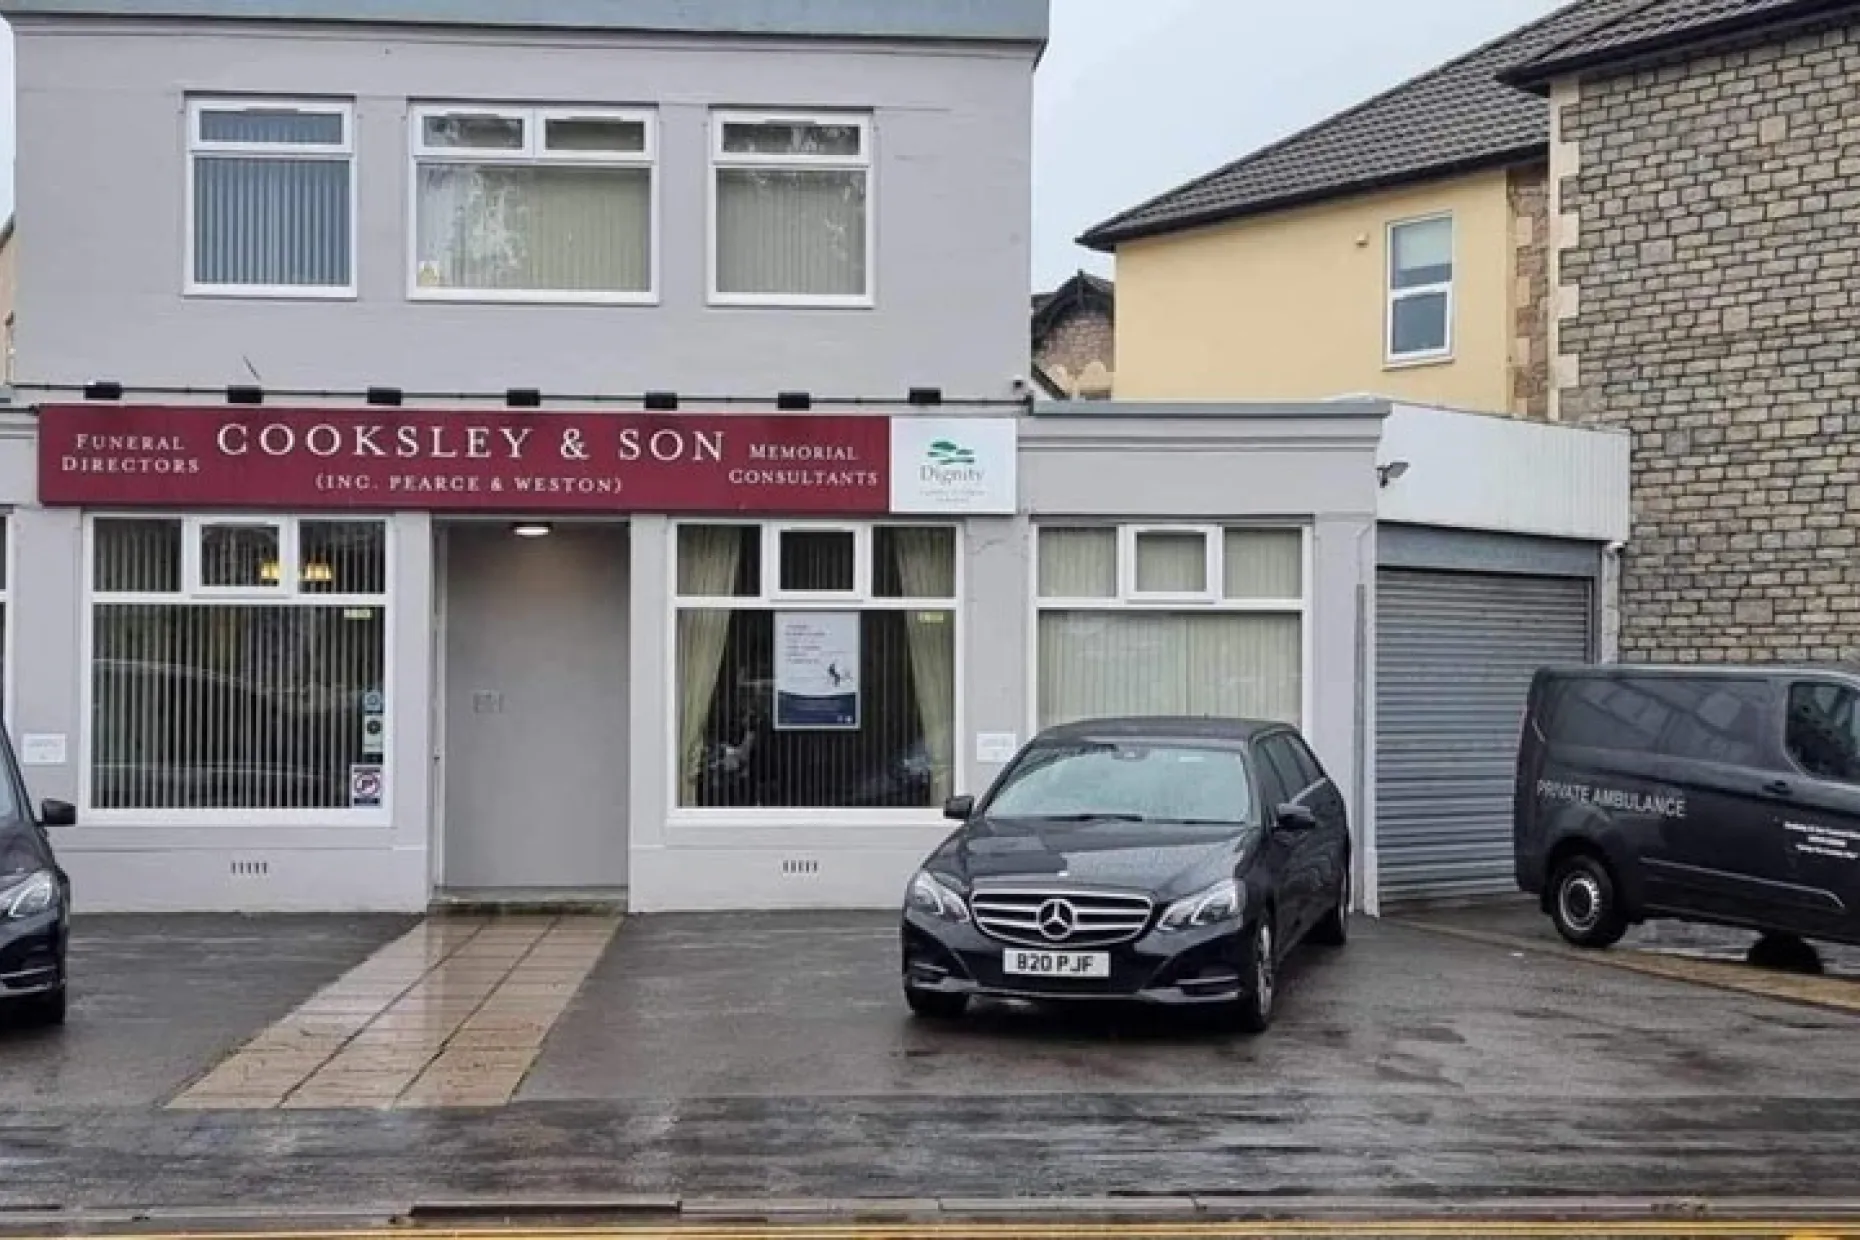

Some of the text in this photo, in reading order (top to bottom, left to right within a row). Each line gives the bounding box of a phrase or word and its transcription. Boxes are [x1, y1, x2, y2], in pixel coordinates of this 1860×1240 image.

[75, 433, 185, 451] FUNERAL
[217, 423, 726, 462] COOKSLEY & SON
[749, 443, 859, 461] MEMORIAL
[61, 456, 200, 474] DIRECTORS
[919, 464, 984, 486] Dignity
[315, 474, 624, 494] (INC. PEARCE & WESTON)
[728, 469, 878, 487] CONSULTANTS
[1536, 779, 1687, 818] PRIVATE AMBULANCE
[1017, 952, 1094, 972] B20 PJF
